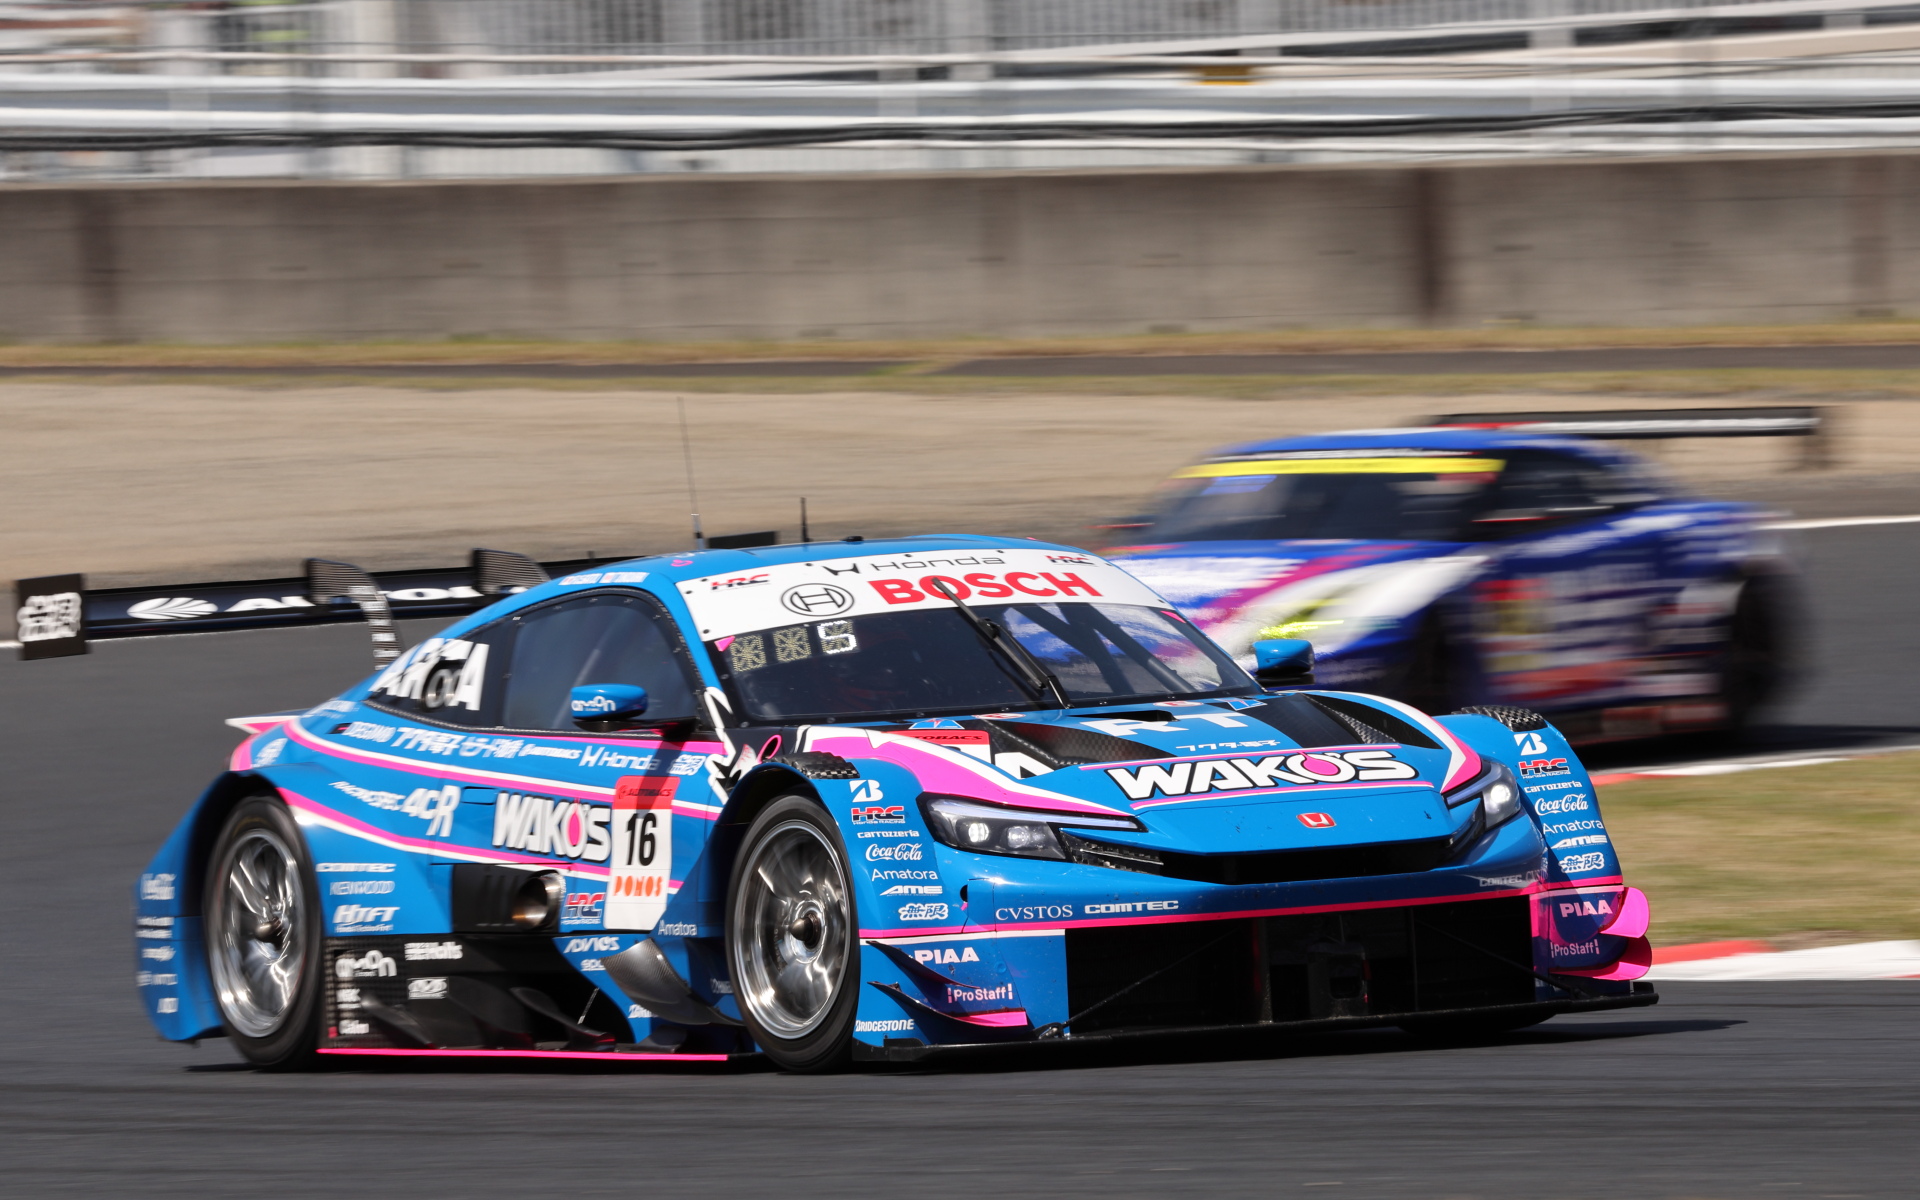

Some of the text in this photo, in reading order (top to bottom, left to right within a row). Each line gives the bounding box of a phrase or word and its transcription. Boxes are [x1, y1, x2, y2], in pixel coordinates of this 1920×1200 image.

[871, 557, 1005, 571] Honda
[867, 571, 1103, 605] BOSCH
[598, 751, 662, 771] Honda
[1518, 758, 1569, 776] HRC
[1524, 781, 1582, 793] carrozzeria
[851, 806, 904, 821] HRC
[857, 830, 920, 838] carrozzeria
[1543, 820, 1604, 835] Amatora
[625, 812, 657, 866] 16
[1551, 835, 1608, 849] AME
[872, 869, 938, 881] Amatora
[879, 885, 943, 896] AME
[995, 905, 1073, 920] CVSTOS
[1084, 900, 1179, 914] COMTEC
[1559, 900, 1613, 917] PIAA
[658, 920, 698, 935] Amatora
[914, 947, 980, 965] PIAA
[855, 1019, 915, 1032] BRIDGESTONE
